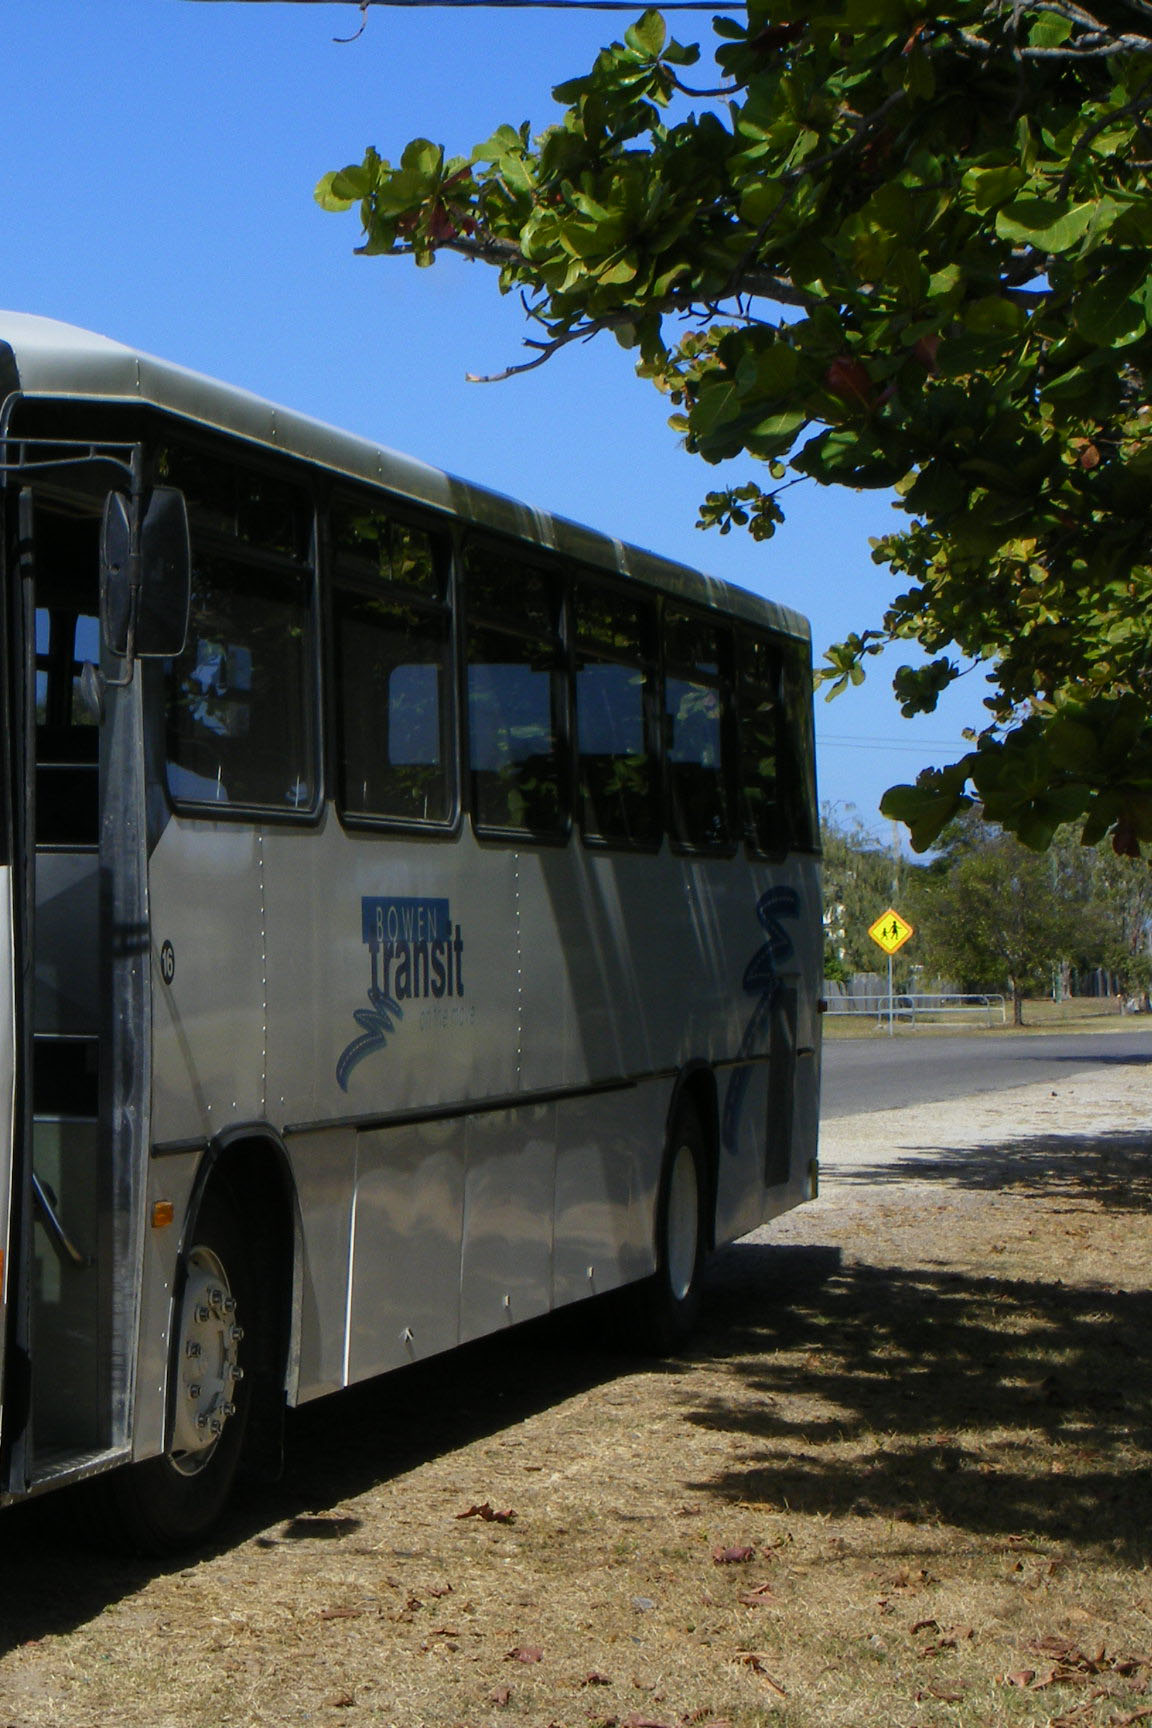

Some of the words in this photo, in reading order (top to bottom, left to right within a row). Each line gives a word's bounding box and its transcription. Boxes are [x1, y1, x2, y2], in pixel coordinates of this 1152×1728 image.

[376, 906, 437, 943] BOWEN
[162, 947, 174, 978] 16
[368, 920, 464, 1000] transit
